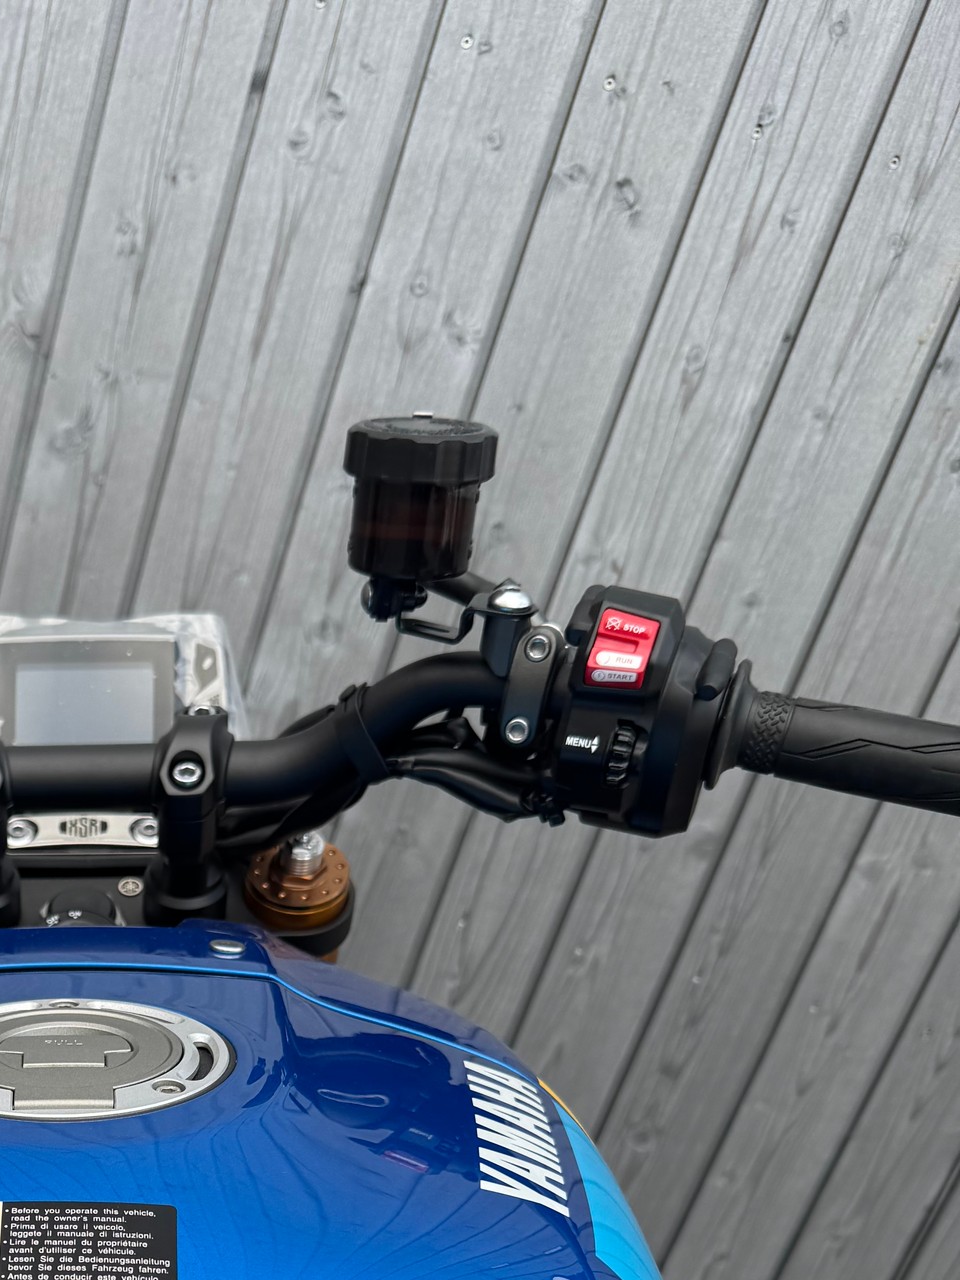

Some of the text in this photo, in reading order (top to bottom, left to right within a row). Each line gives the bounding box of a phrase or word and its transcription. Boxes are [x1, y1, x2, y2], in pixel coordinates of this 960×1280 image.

[623, 623, 646, 635] STOP
[615, 656, 634, 665] RUN
[607, 672, 634, 681] START
[565, 736, 592, 749] MENU
[69, 817, 98, 838] XSR
[463, 1060, 570, 1217] YAMAHA
[103, 1208, 119, 1216] this
[123, 1210, 156, 1218] vehicle,
[83, 1223, 89, 1231] il
[93, 1224, 125, 1232] veicolo,
[112, 1232, 154, 1240] istruzioni.
[78, 1256, 171, 1267] Bedienungsanleitung
[57, 1264, 87, 1272] dieses
[92, 1265, 134, 1274] Fahrzeug
[138, 1266, 169, 1274] fahren.
[54, 1273, 93, 1280] conducir
